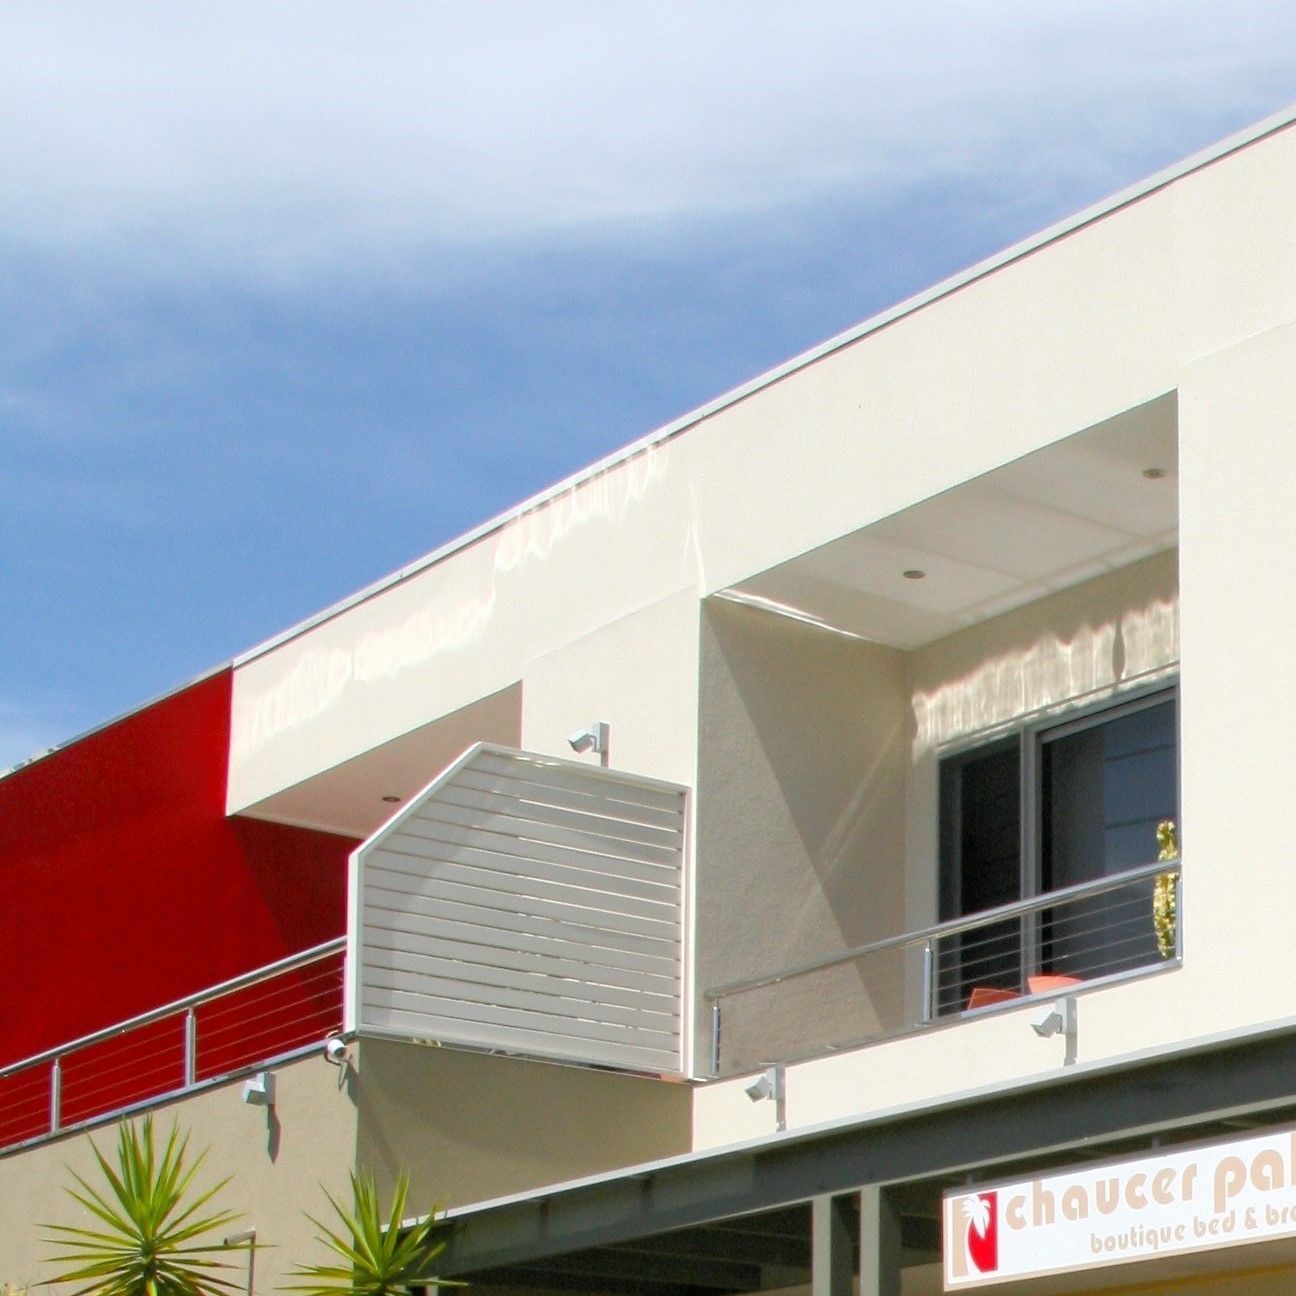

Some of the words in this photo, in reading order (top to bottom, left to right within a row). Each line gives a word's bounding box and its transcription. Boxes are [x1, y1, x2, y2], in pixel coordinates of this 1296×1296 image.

[1006, 1163, 1197, 1230] chaucer
[1090, 1223, 1186, 1254] boutique
[1193, 1210, 1236, 1237] bed
[1244, 1208, 1259, 1230] &
